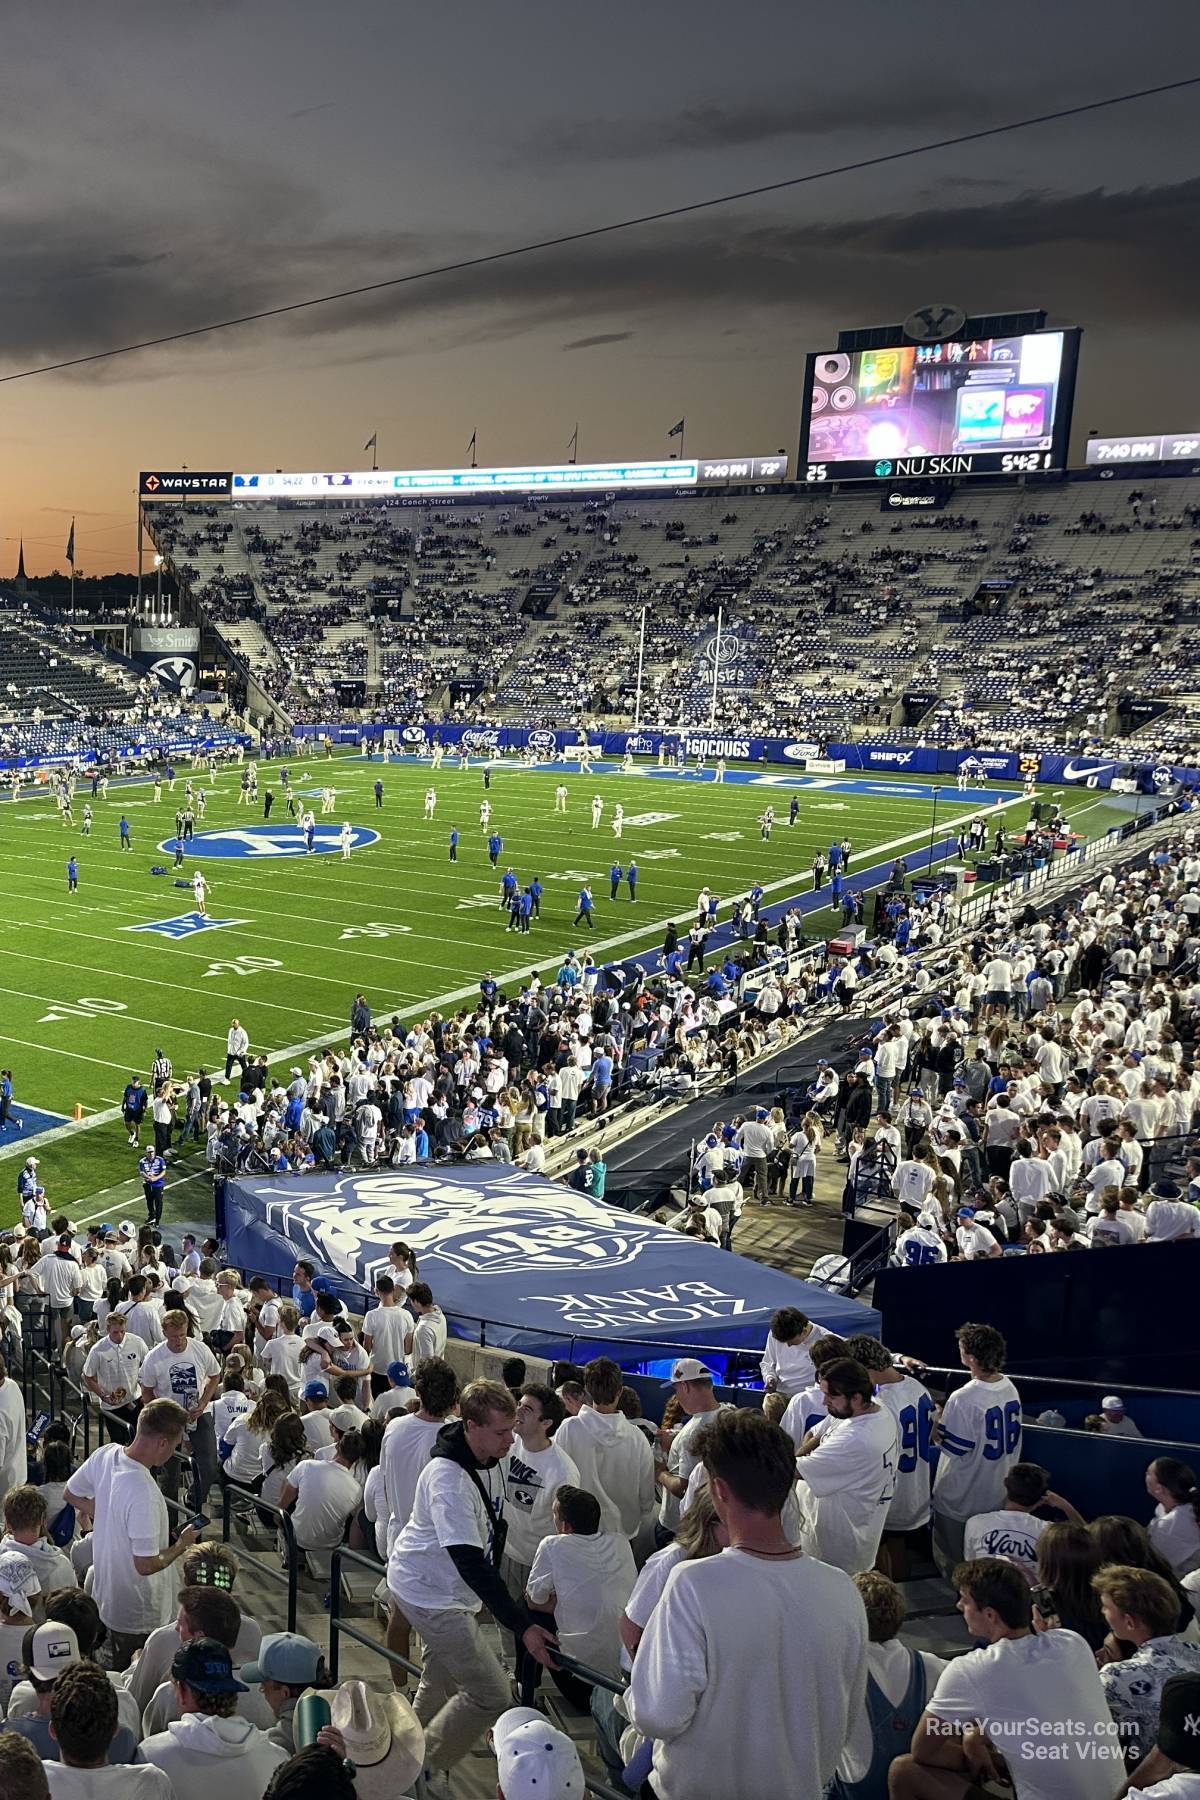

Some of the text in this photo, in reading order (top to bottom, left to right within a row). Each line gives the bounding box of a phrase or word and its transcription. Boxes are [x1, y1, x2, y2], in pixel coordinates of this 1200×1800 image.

[704, 464, 747, 477] 7:40 PM
[806, 464, 828, 481] 25
[896, 456, 973, 476] NU SKIN
[1001, 453, 1052, 472] 54:21
[161, 478, 227, 488] WAYSTAR
[1020, 760, 1039, 773] 25
[343, 922, 412, 939] 30
[207, 955, 284, 975] 20
[48, 997, 128, 1017] 10
[461, 1224, 594, 1259] BYU
[538, 1280, 733, 1312] BANK
[562, 1298, 771, 1329] ZIONS
[982, 1400, 1021, 1461] 96
[508, 1457, 538, 1481] NIKE
